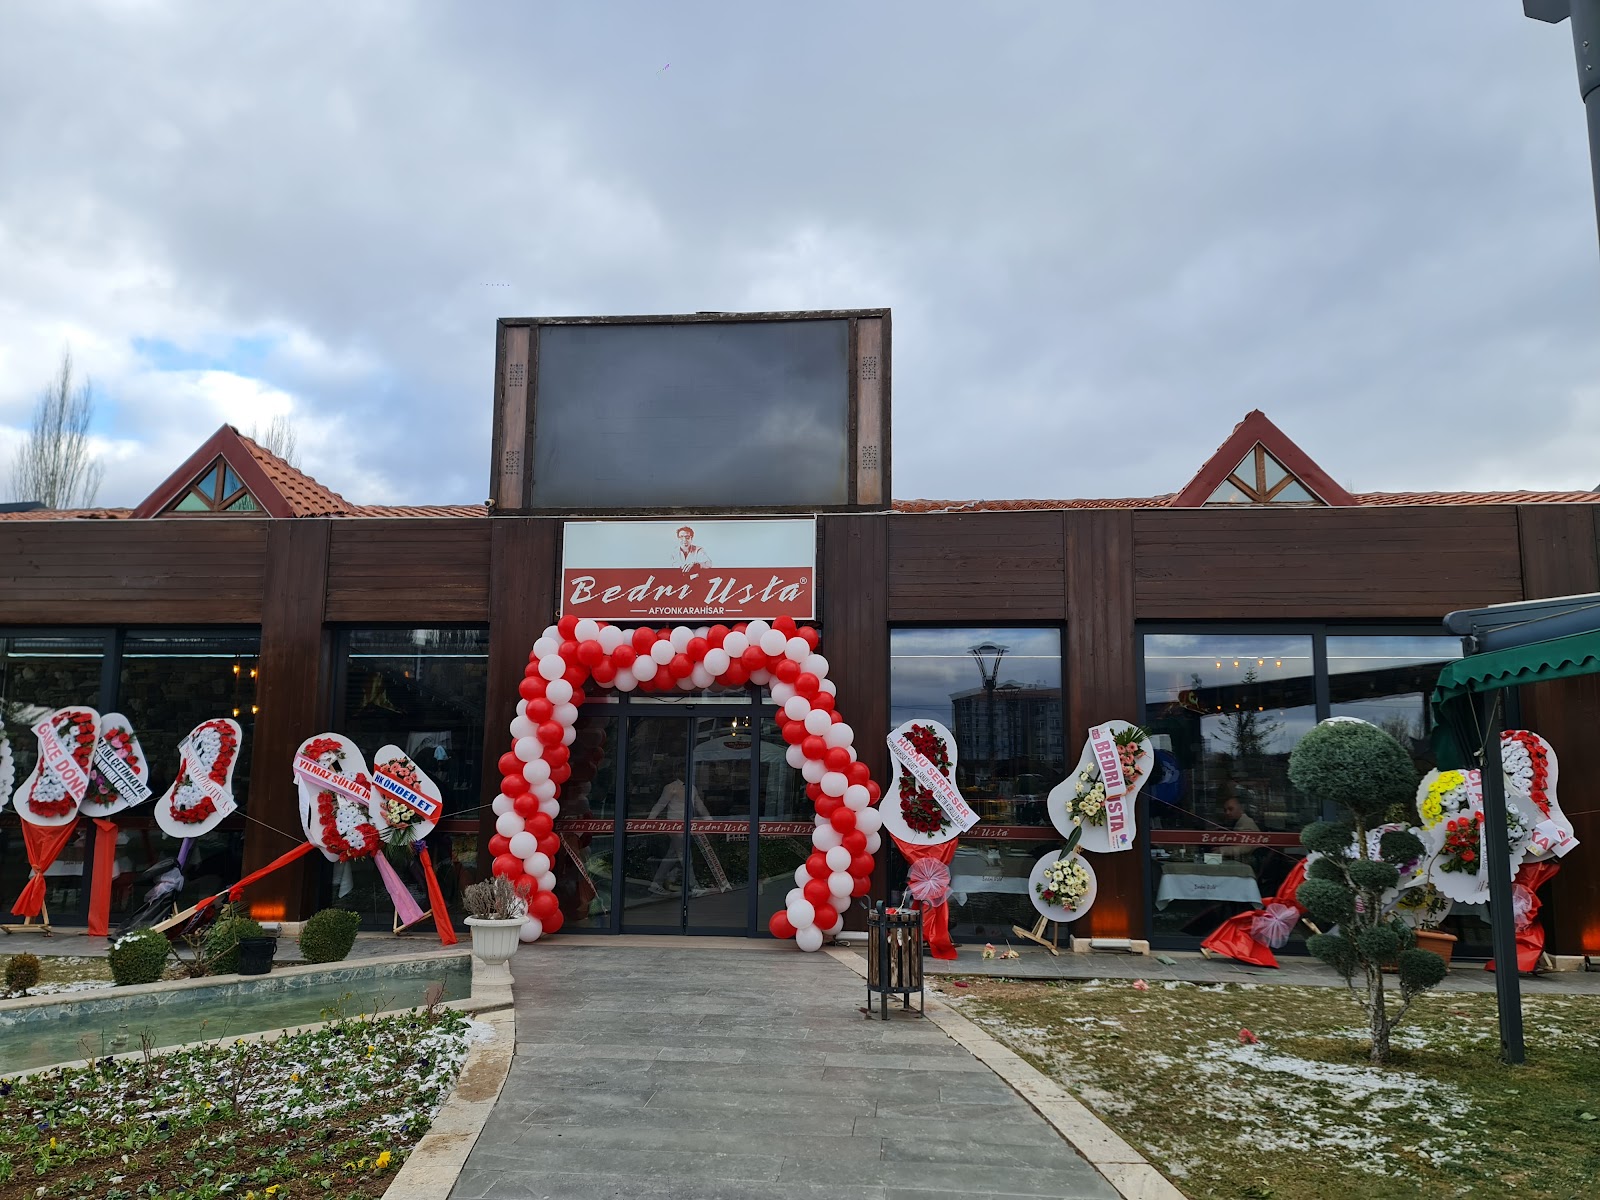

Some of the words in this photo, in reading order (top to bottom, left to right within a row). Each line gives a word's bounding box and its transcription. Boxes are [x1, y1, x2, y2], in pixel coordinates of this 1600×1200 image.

[569, 573, 699, 605] Bedri
[704, 575, 804, 605] Usta
[648, 605, 725, 615] AFYONKARAHİSAR
[37, 722, 63, 762] GAMZE
[54, 759, 87, 799] DÖNE
[1094, 740, 1123, 788] BEDRİ
[110, 753, 146, 794] ÇETİNKAYA
[299, 760, 331, 779] YILMAZ
[331, 774, 363, 795] SÜLÜK
[896, 737, 929, 768] HÜSNÜ
[926, 767, 970, 818] SERTESER
[383, 778, 418, 806] ÖNDER
[418, 799, 433, 812] ET
[555, 821, 587, 831] Bedri
[588, 822, 613, 831] Usta
[625, 821, 657, 831] Bedri
[658, 822, 684, 831] Usta
[690, 822, 722, 832] Bedri
[723, 823, 749, 832] Usta
[759, 823, 792, 833] Bedri
[981, 828, 1009, 837] Usta
[1201, 833, 1237, 843] Bedri
